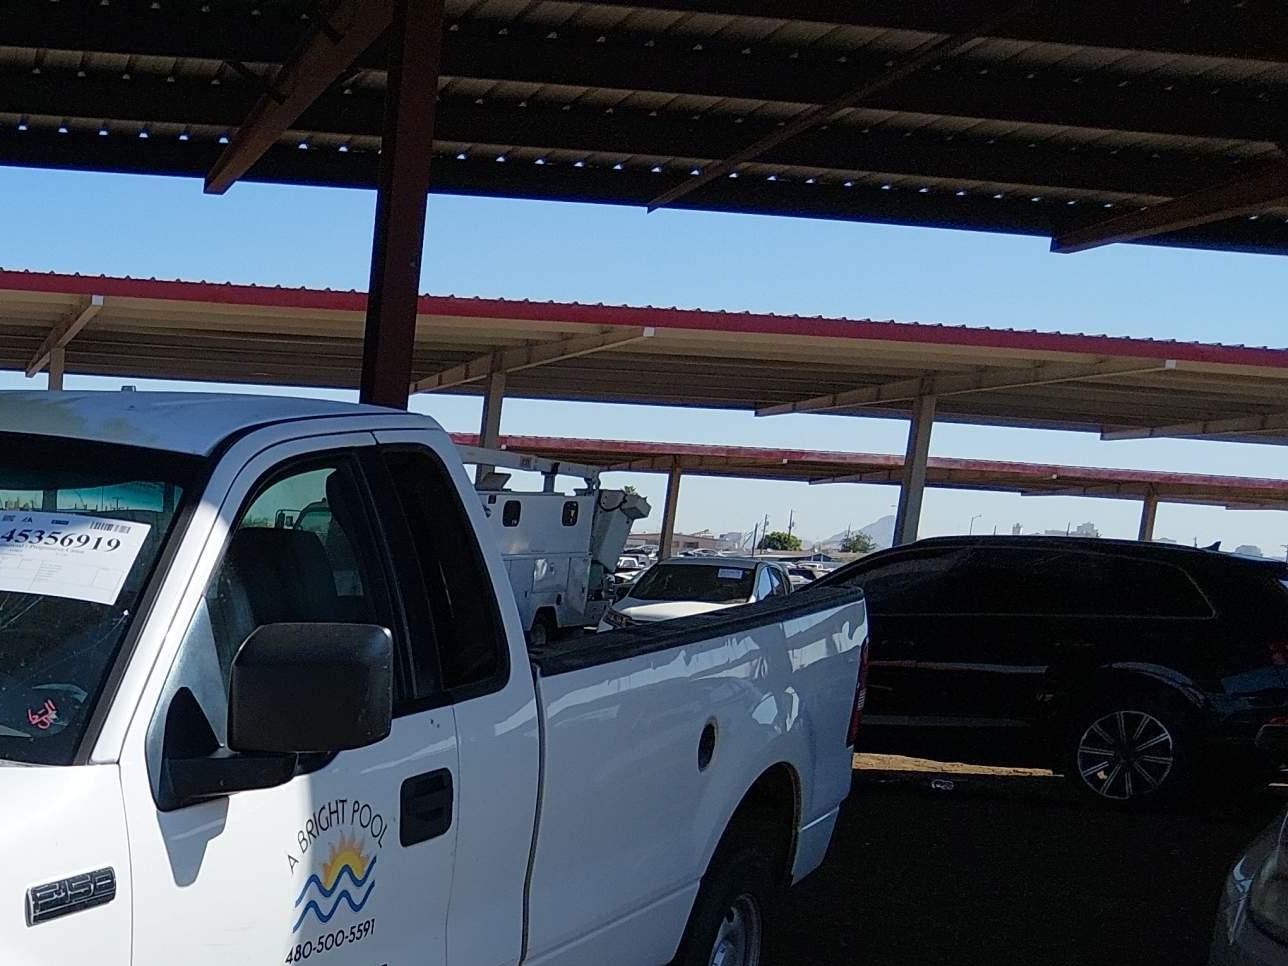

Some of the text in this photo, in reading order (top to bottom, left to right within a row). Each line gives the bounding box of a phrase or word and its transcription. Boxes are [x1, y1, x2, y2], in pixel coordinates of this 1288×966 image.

[0, 528, 122, 552] 45356919
[287, 800, 388, 875] A BRIGHT POOL
[284, 918, 376, 965] 480-500-5591
